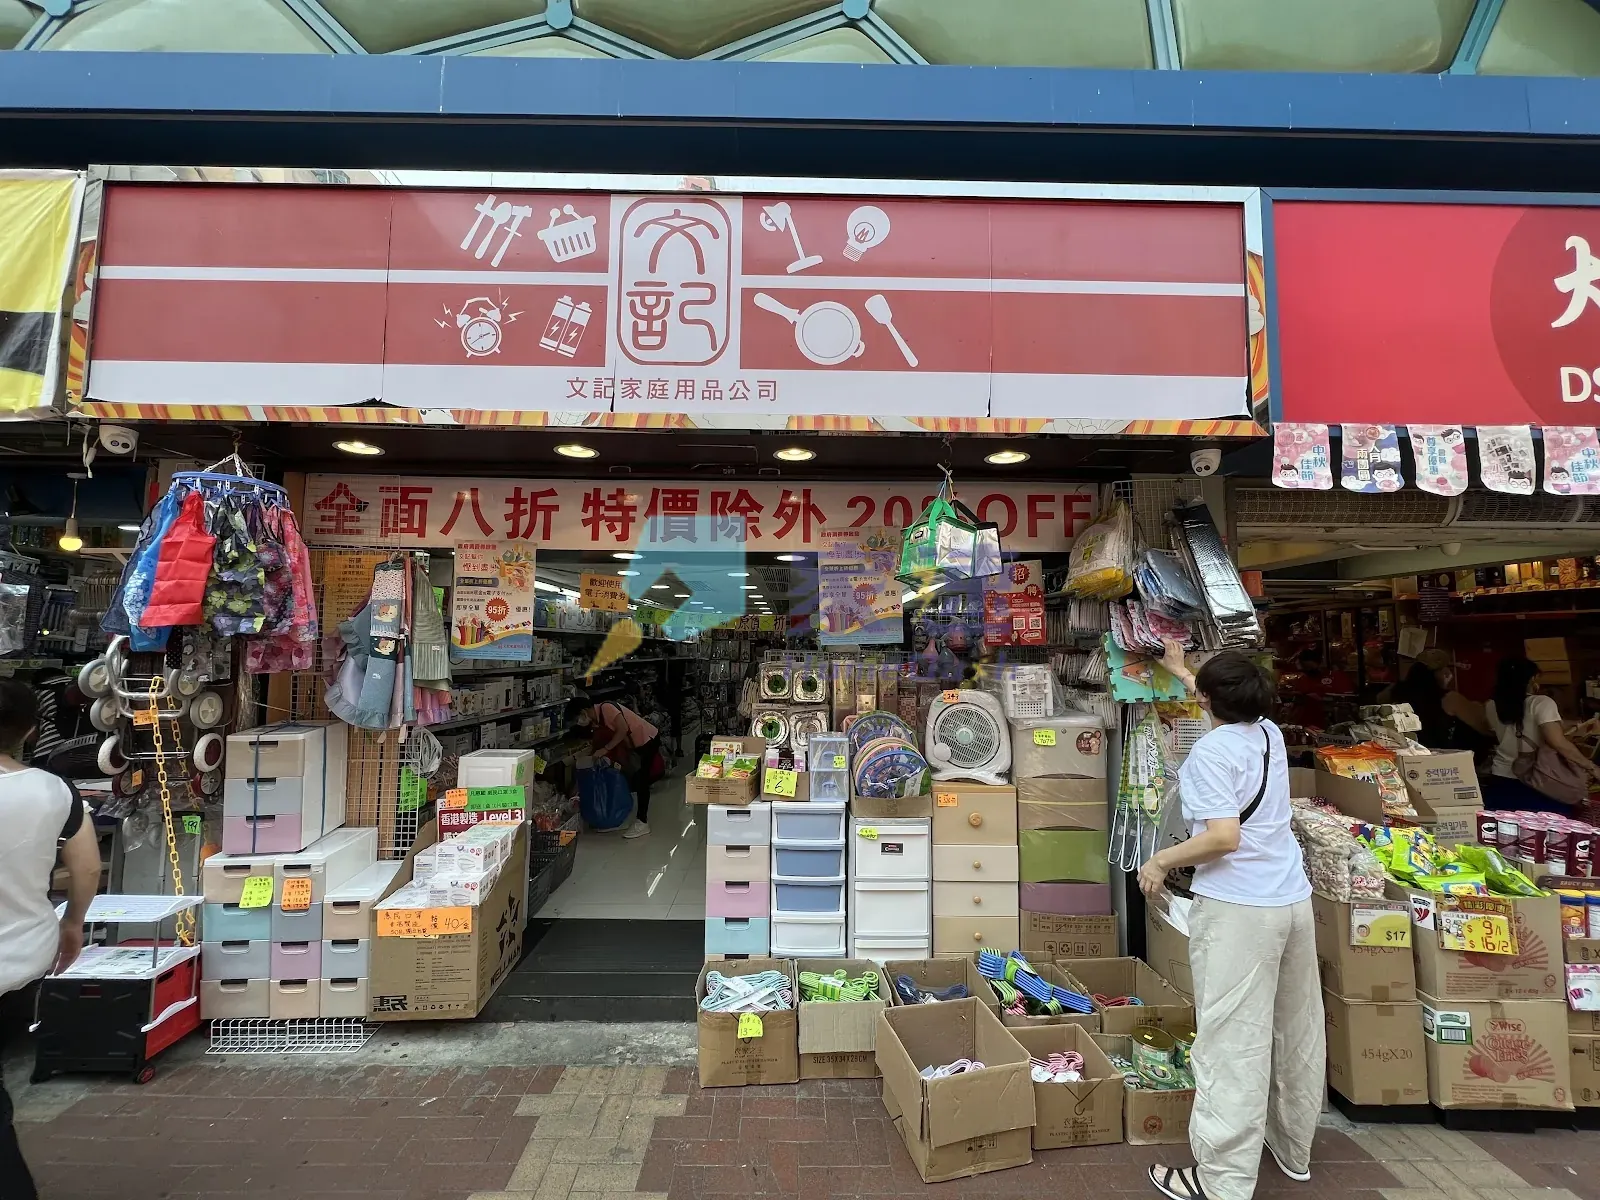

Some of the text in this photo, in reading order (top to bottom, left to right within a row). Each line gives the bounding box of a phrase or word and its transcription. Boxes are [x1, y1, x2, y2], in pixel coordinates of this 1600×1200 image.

[566, 376, 777, 402] 文記家庭用品公司
[1560, 366, 1600, 403] D
[1312, 444, 1326, 468] 中秋
[1582, 447, 1599, 469] 中秋
[1300, 458, 1315, 481] 佳節
[1571, 461, 1588, 483] 佳節
[315, 482, 560, 541] 全面八折
[581, 487, 827, 543] 特價除外
[585, 588, 626, 600] 電子消費券
[487, 604, 507, 615] 95折
[441, 808, 522, 825] 香港製造 Level 3
[1385, 930, 1406, 941] $17
[812, 1056, 826, 1064] SIZE
[1361, 1048, 1413, 1062] 454gX20
